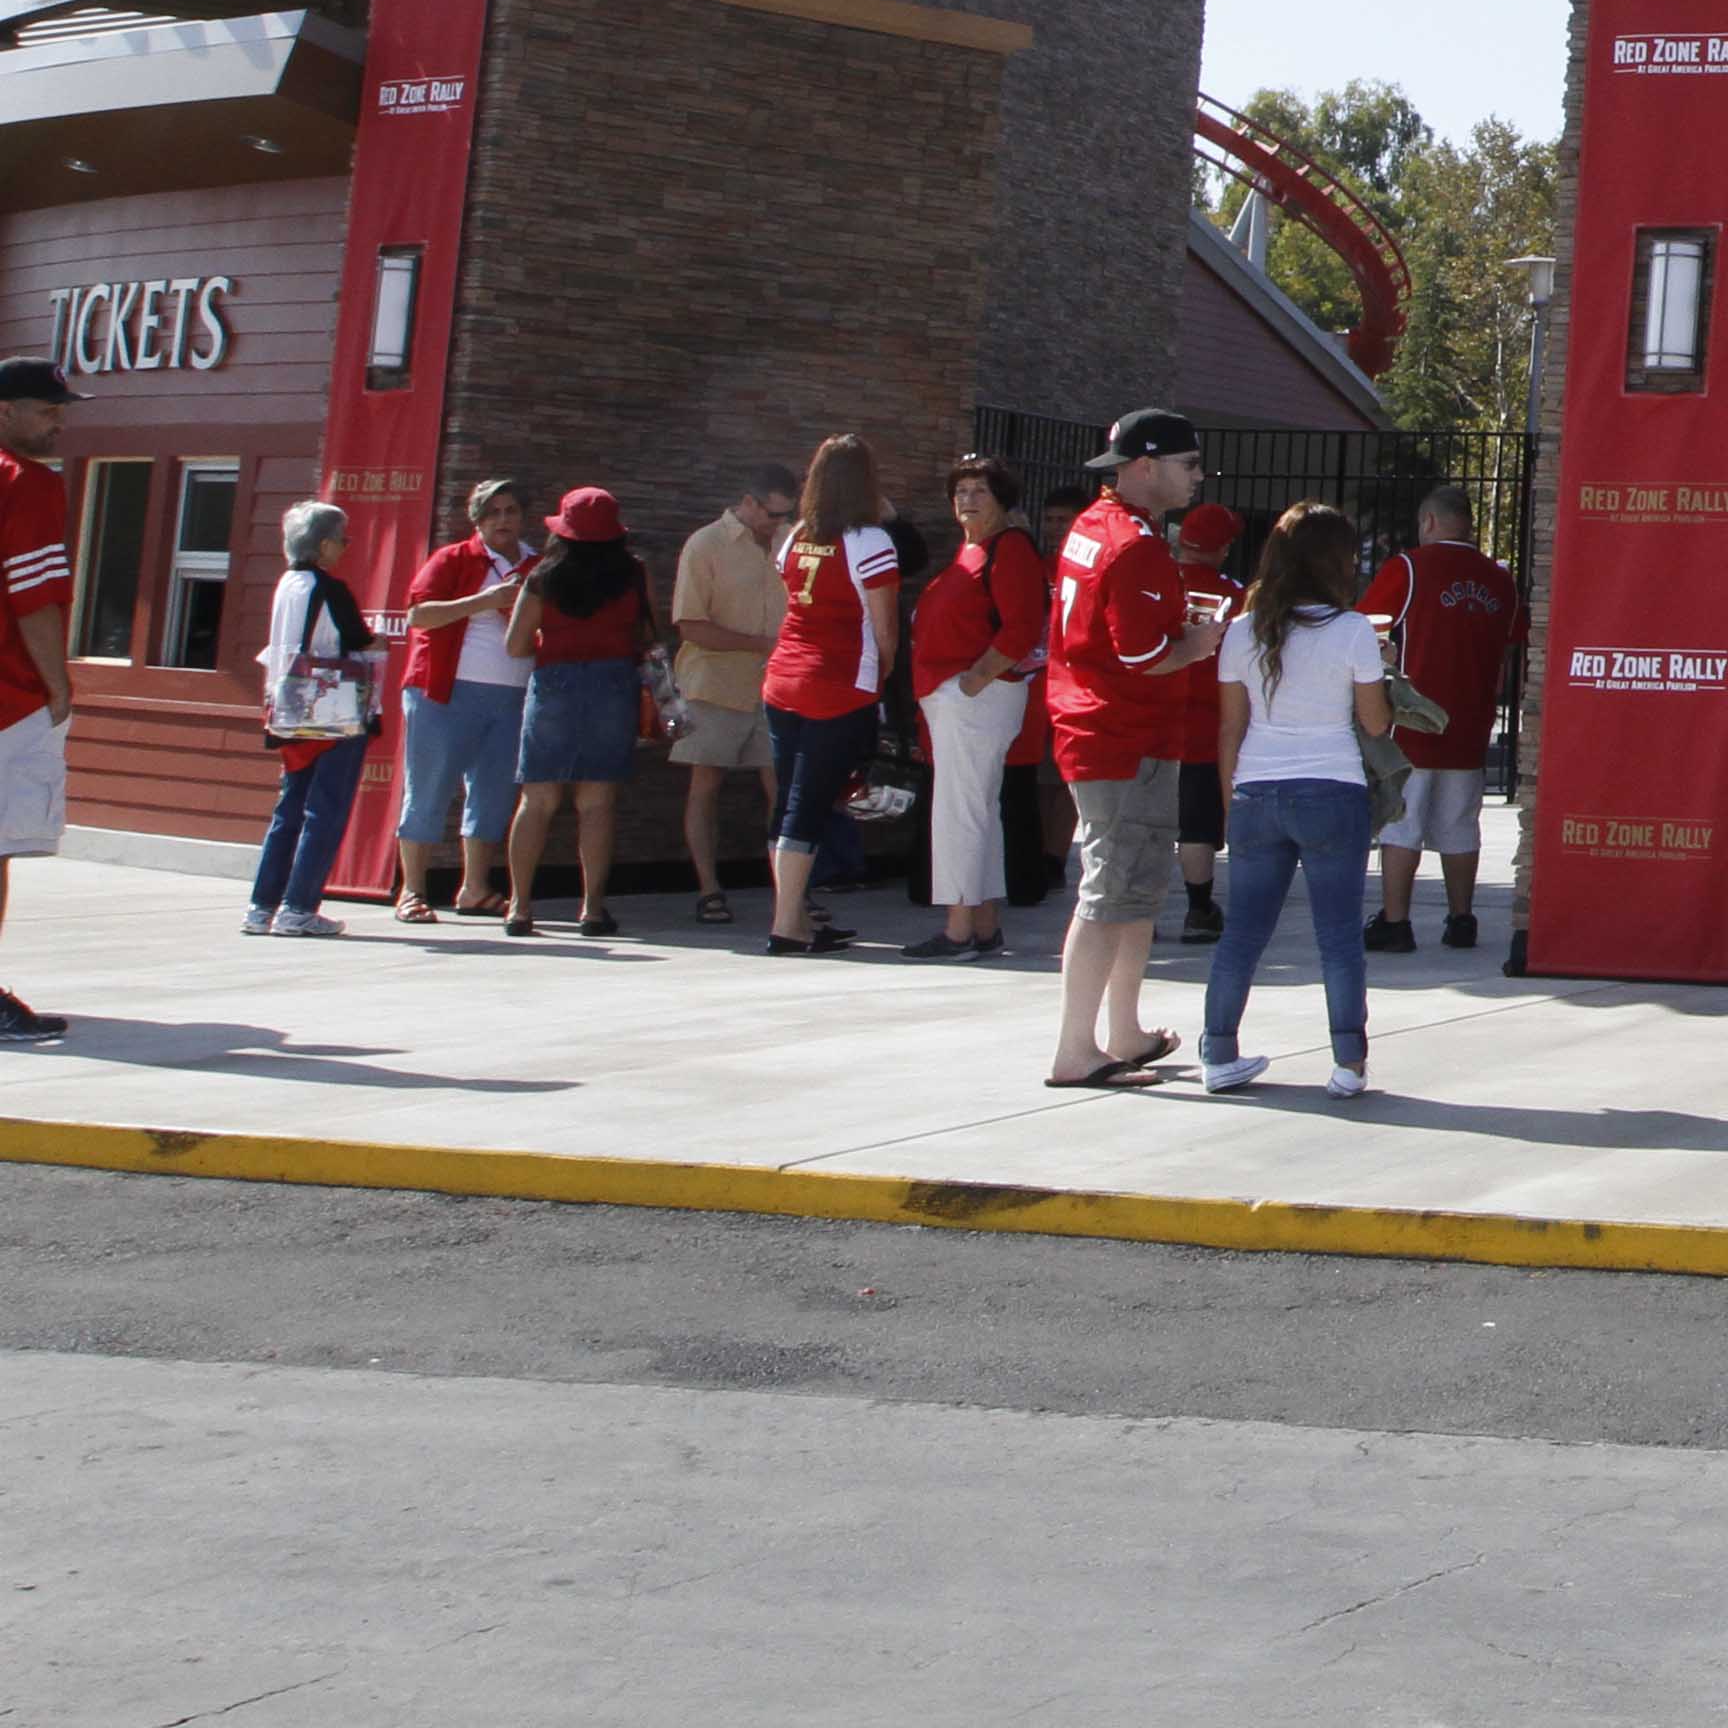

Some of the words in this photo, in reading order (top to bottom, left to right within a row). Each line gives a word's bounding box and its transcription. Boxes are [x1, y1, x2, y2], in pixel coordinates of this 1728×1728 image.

[1614, 40, 1647, 64] RED
[1653, 38, 1701, 62] ZONE
[50, 276, 231, 381] TICKETS
[1579, 486, 1620, 511] RED
[1626, 487, 1668, 512] ZONE
[798, 555, 821, 605] 7
[1569, 652, 1606, 677] RED
[1611, 652, 1662, 678] ZONE
[1669, 654, 1728, 680] RALLY
[1562, 820, 1600, 845] RED
[1606, 821, 1655, 847] ZONE
[1662, 823, 1713, 849] RALLY
